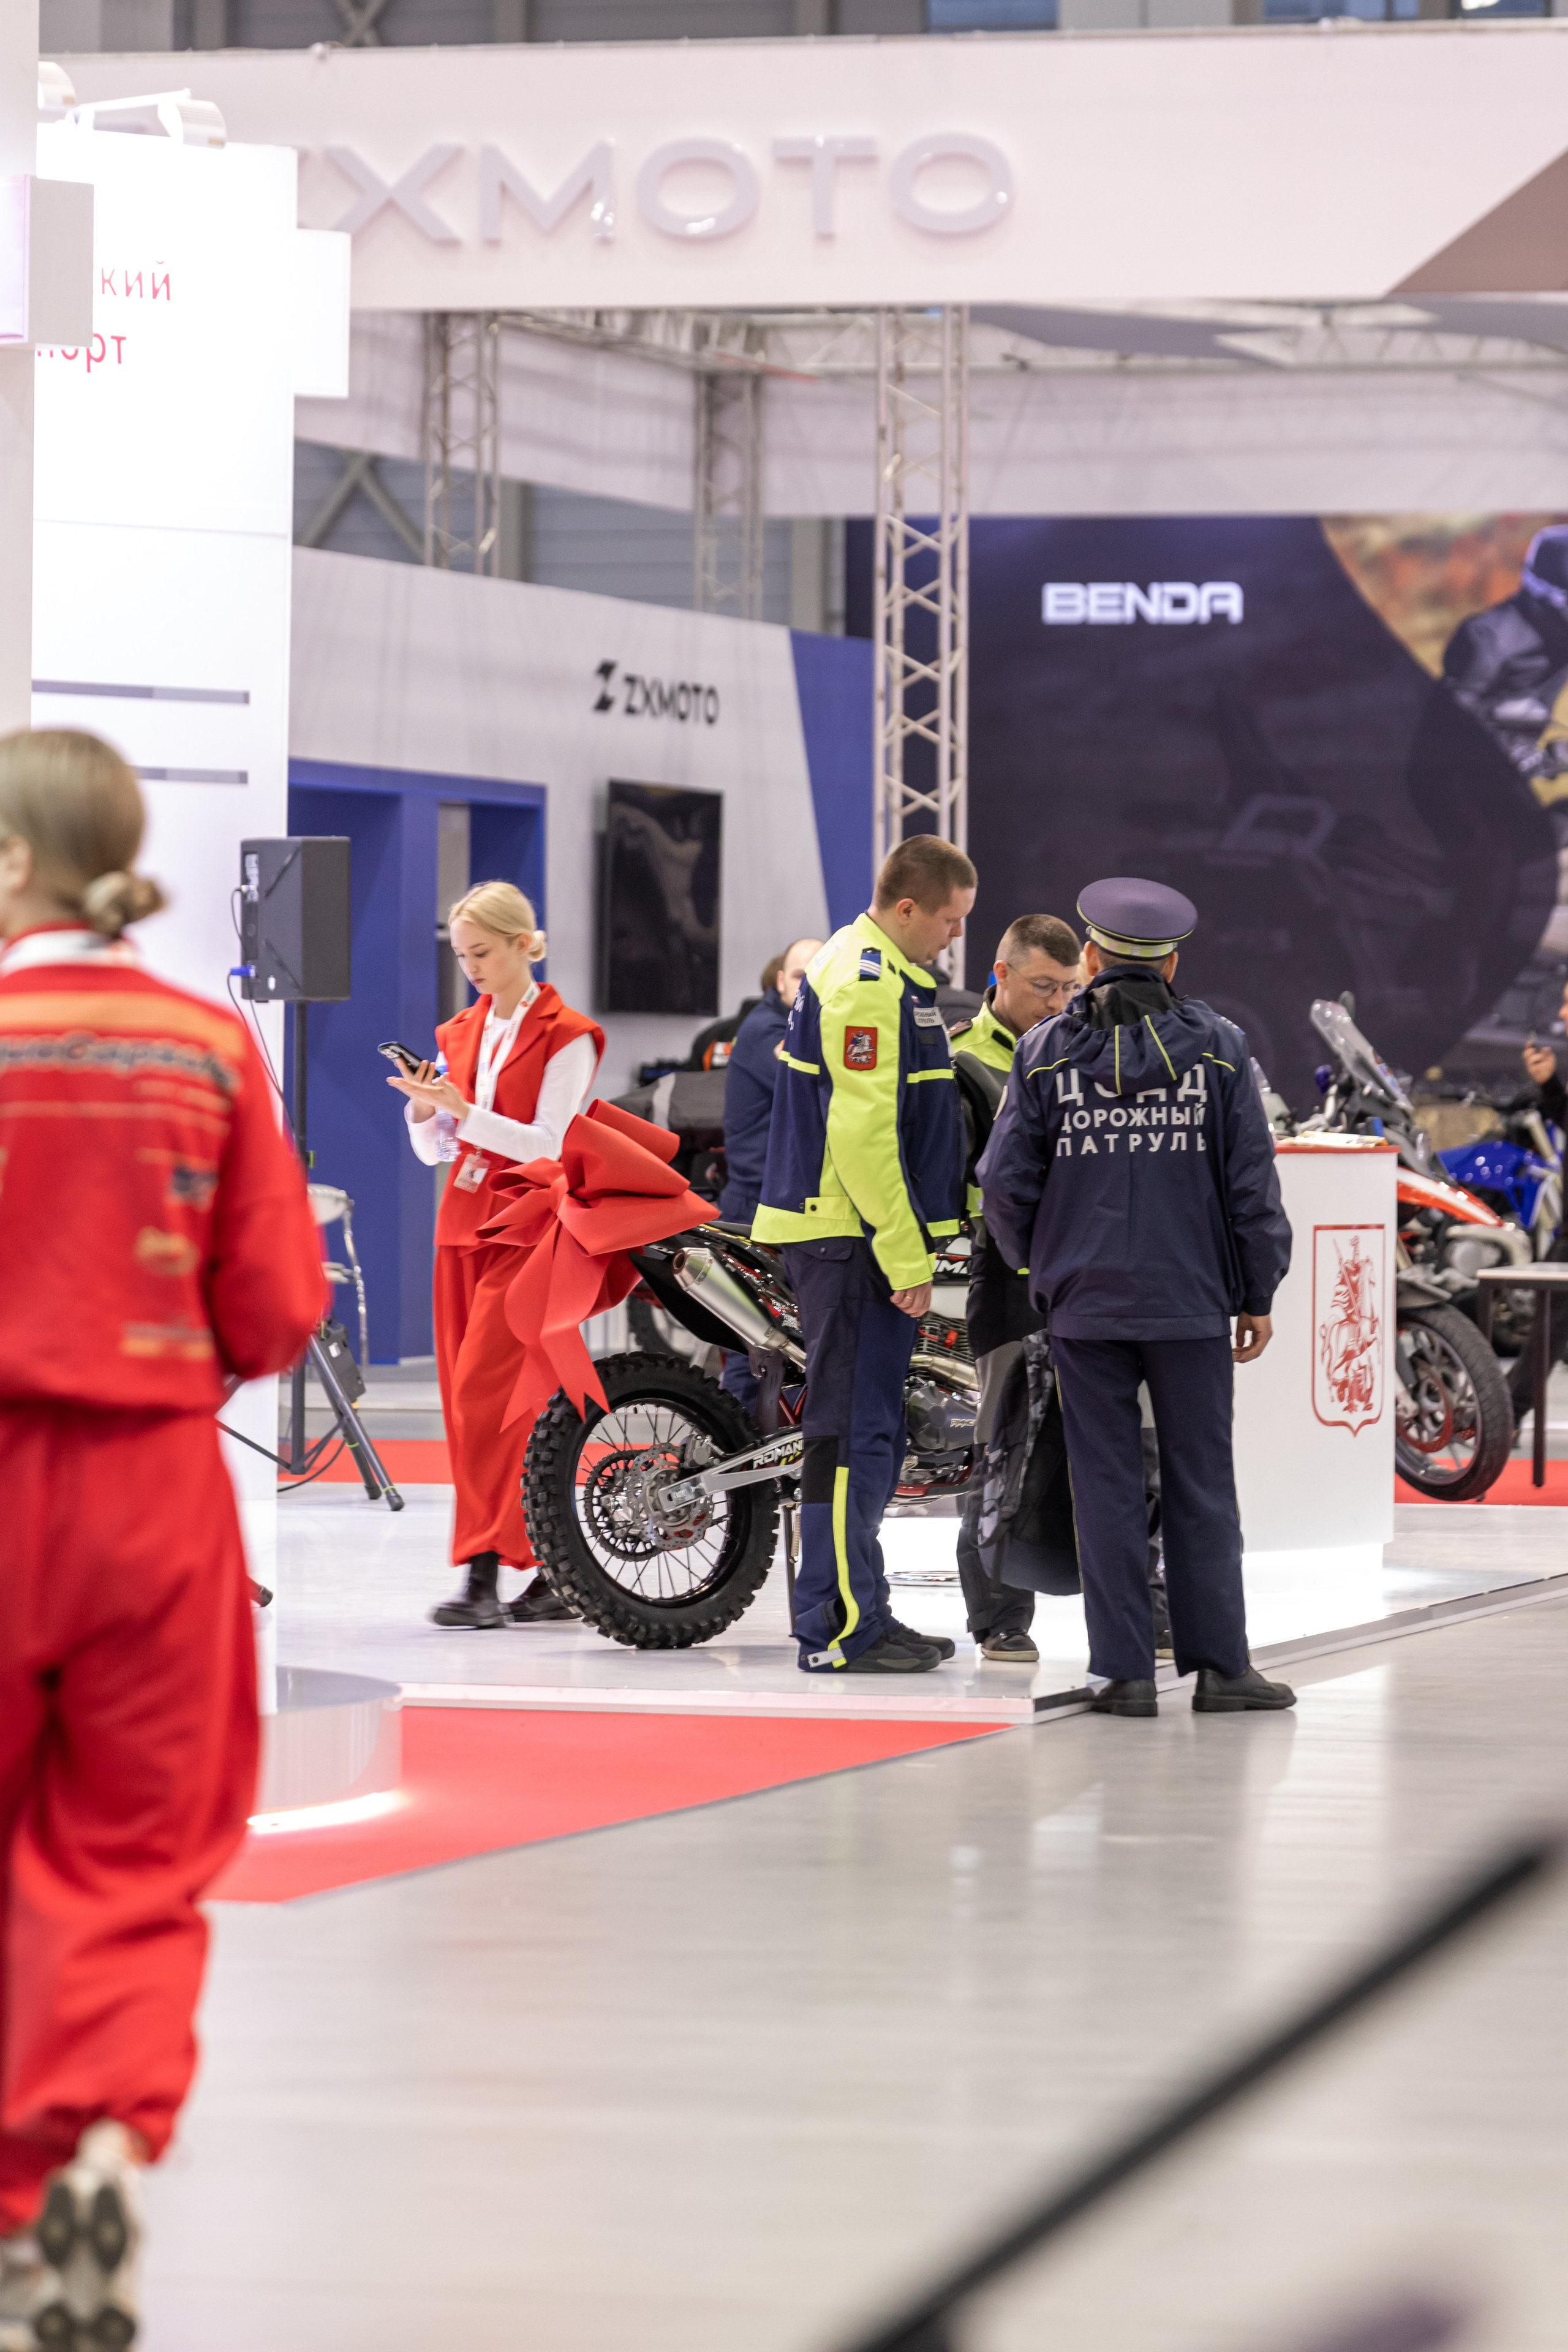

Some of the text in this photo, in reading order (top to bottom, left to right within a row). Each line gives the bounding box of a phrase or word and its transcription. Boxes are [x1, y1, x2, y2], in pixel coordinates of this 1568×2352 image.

[298, 131, 1014, 246] XMOTO
[101, 260, 170, 301] кий
[1042, 581, 1245, 625] BENDA
[624, 674, 720, 725] ZXMOTO
[1061, 1102, 1206, 1134] ДОРОЖНЫЙ
[1056, 1131, 1207, 1157] ПАТРУЛЬ
